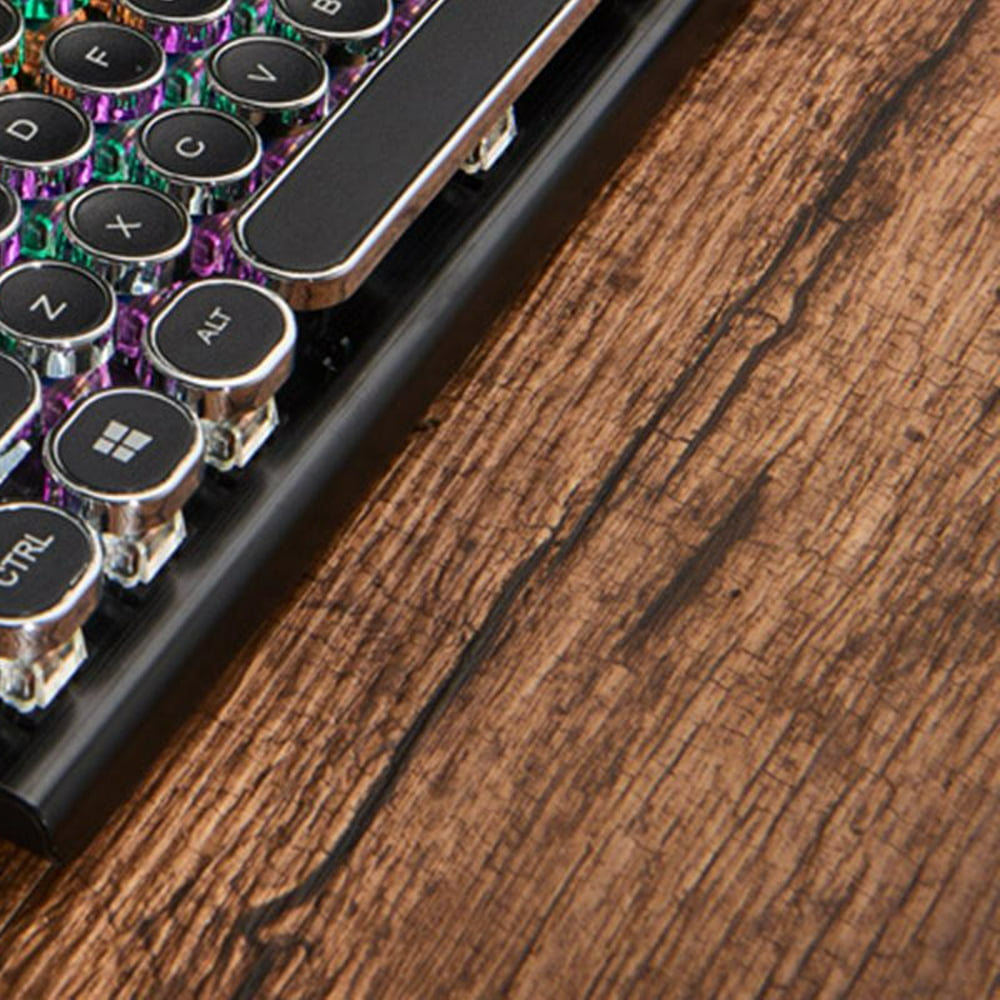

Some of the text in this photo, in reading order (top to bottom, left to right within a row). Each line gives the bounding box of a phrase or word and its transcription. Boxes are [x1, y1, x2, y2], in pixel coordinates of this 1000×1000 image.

[85, 45, 109, 67] F
[247, 63, 277, 82] V
[5, 119, 39, 142] D
[175, 136, 205, 158] C
[105, 214, 142, 239] X
[29, 294, 67, 321] Z
[197, 306, 231, 345] ALT
